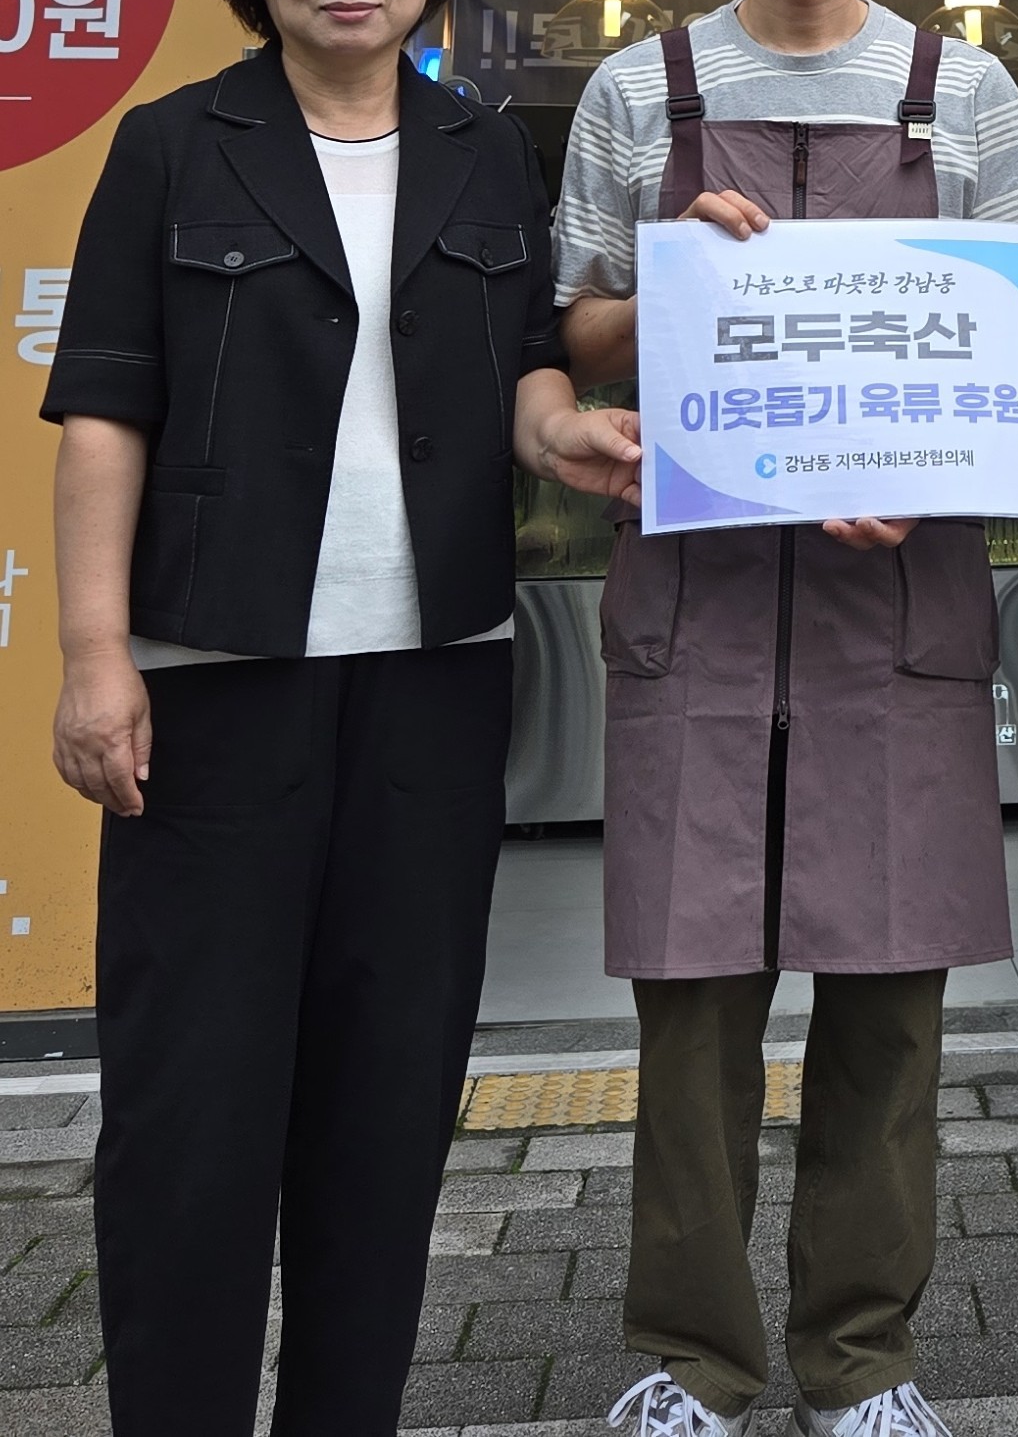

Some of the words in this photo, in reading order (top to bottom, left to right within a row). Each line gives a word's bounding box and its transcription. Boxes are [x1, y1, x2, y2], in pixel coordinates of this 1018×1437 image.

[732, 272, 818, 297] 나눔으로
[823, 272, 889, 296] 따뜻한
[894, 270, 956, 295] 강남동
[713, 310, 977, 364] 모두축산
[680, 384, 848, 432] 이웃돕기
[859, 382, 943, 424] 육류
[785, 453, 832, 474] 강남동
[835, 449, 975, 471] 지역사회보장협의체
